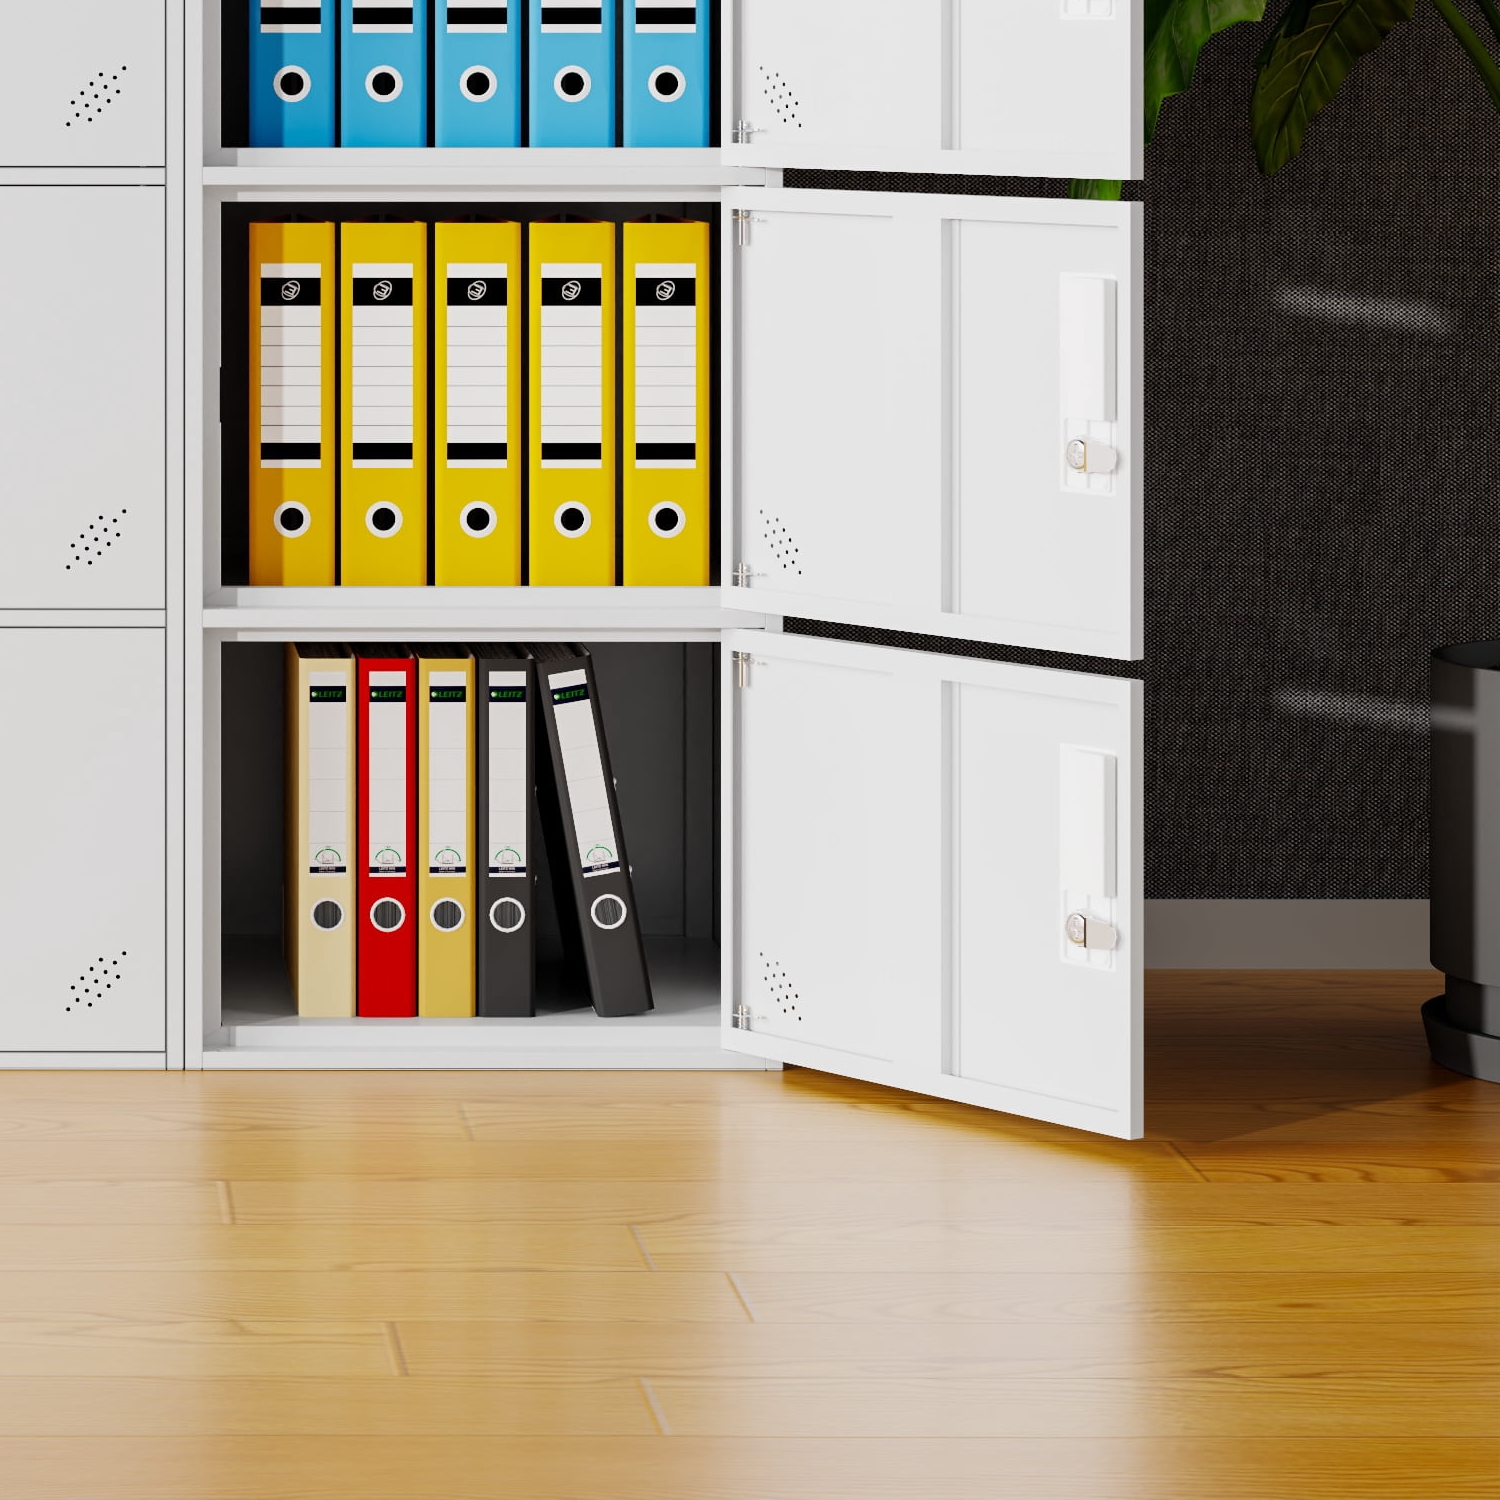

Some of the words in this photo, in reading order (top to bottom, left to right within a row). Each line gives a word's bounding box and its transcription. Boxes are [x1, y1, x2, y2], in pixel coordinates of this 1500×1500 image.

[318, 690, 343, 698] LEITZ
[378, 690, 403, 698] LEITZ
[438, 690, 463, 698] LEITZ
[498, 690, 523, 698] LEITZ
[560, 689, 585, 699] LEITZ
